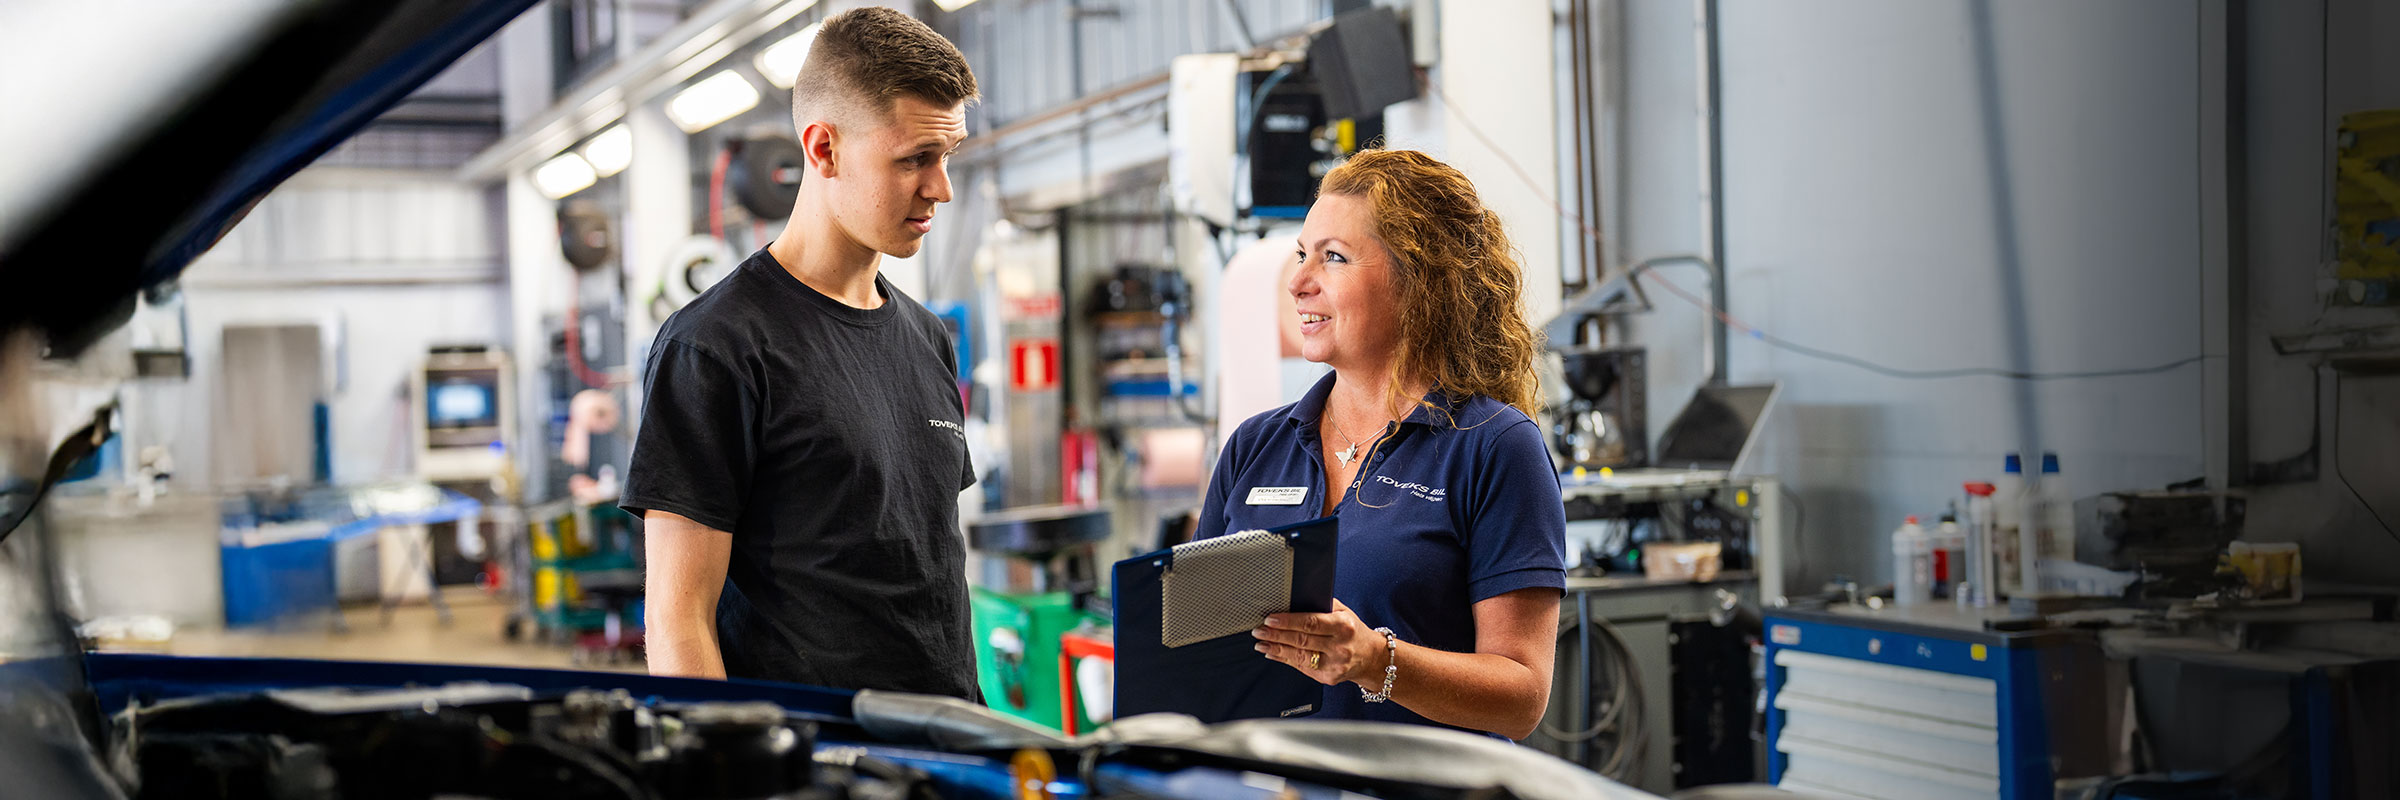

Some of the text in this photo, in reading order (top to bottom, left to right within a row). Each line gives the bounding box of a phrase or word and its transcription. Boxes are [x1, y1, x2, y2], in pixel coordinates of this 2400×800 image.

[928, 419, 958, 431] TOVEKS
[1376, 475, 1446, 496] TOVEKS BIL
